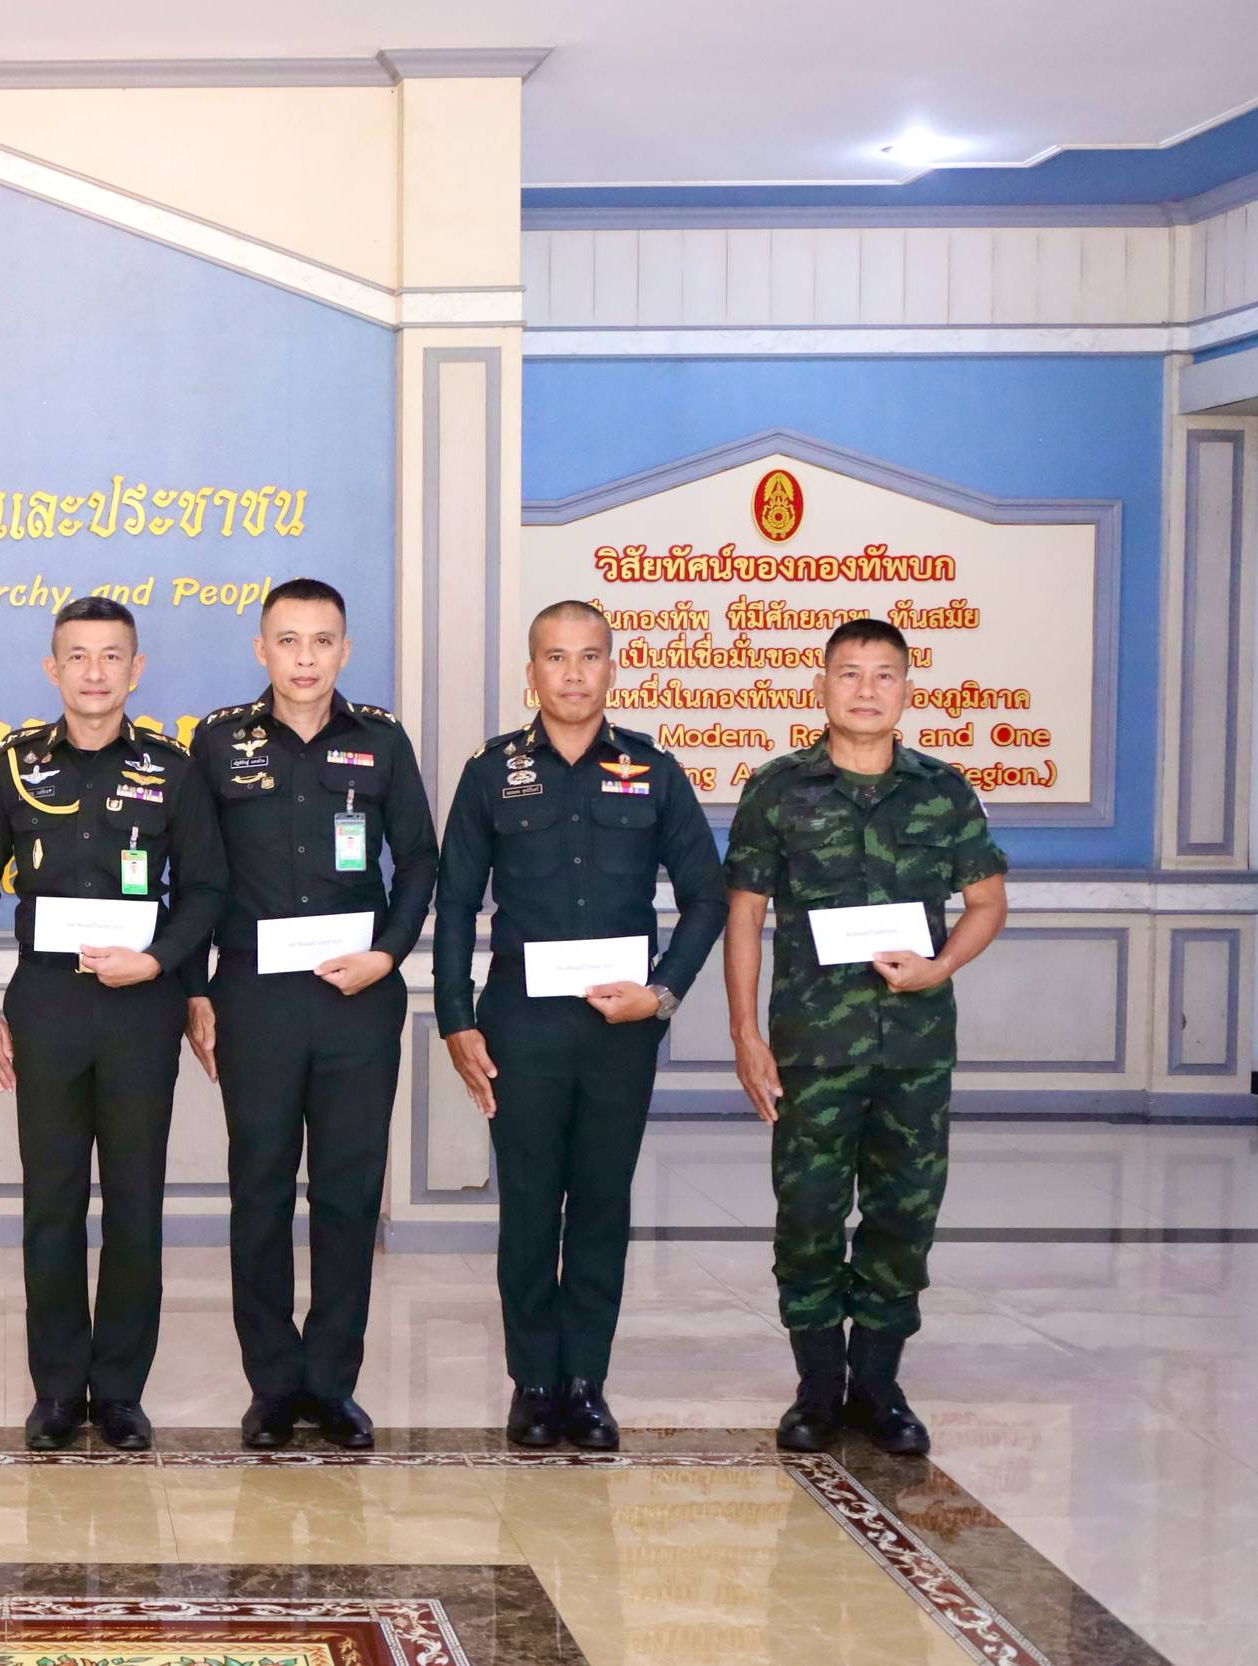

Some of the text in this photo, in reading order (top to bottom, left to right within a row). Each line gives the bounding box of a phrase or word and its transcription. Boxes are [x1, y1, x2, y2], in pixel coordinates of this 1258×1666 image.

[595, 543, 956, 583] วิสัยทัศน์ของกองทัพบก
[172, 575, 272, 615] Peopl
[887, 598, 981, 630] ทันสมัย
[659, 723, 775, 750] Modern,
[918, 722, 974, 747] and
[990, 723, 1052, 747] One
